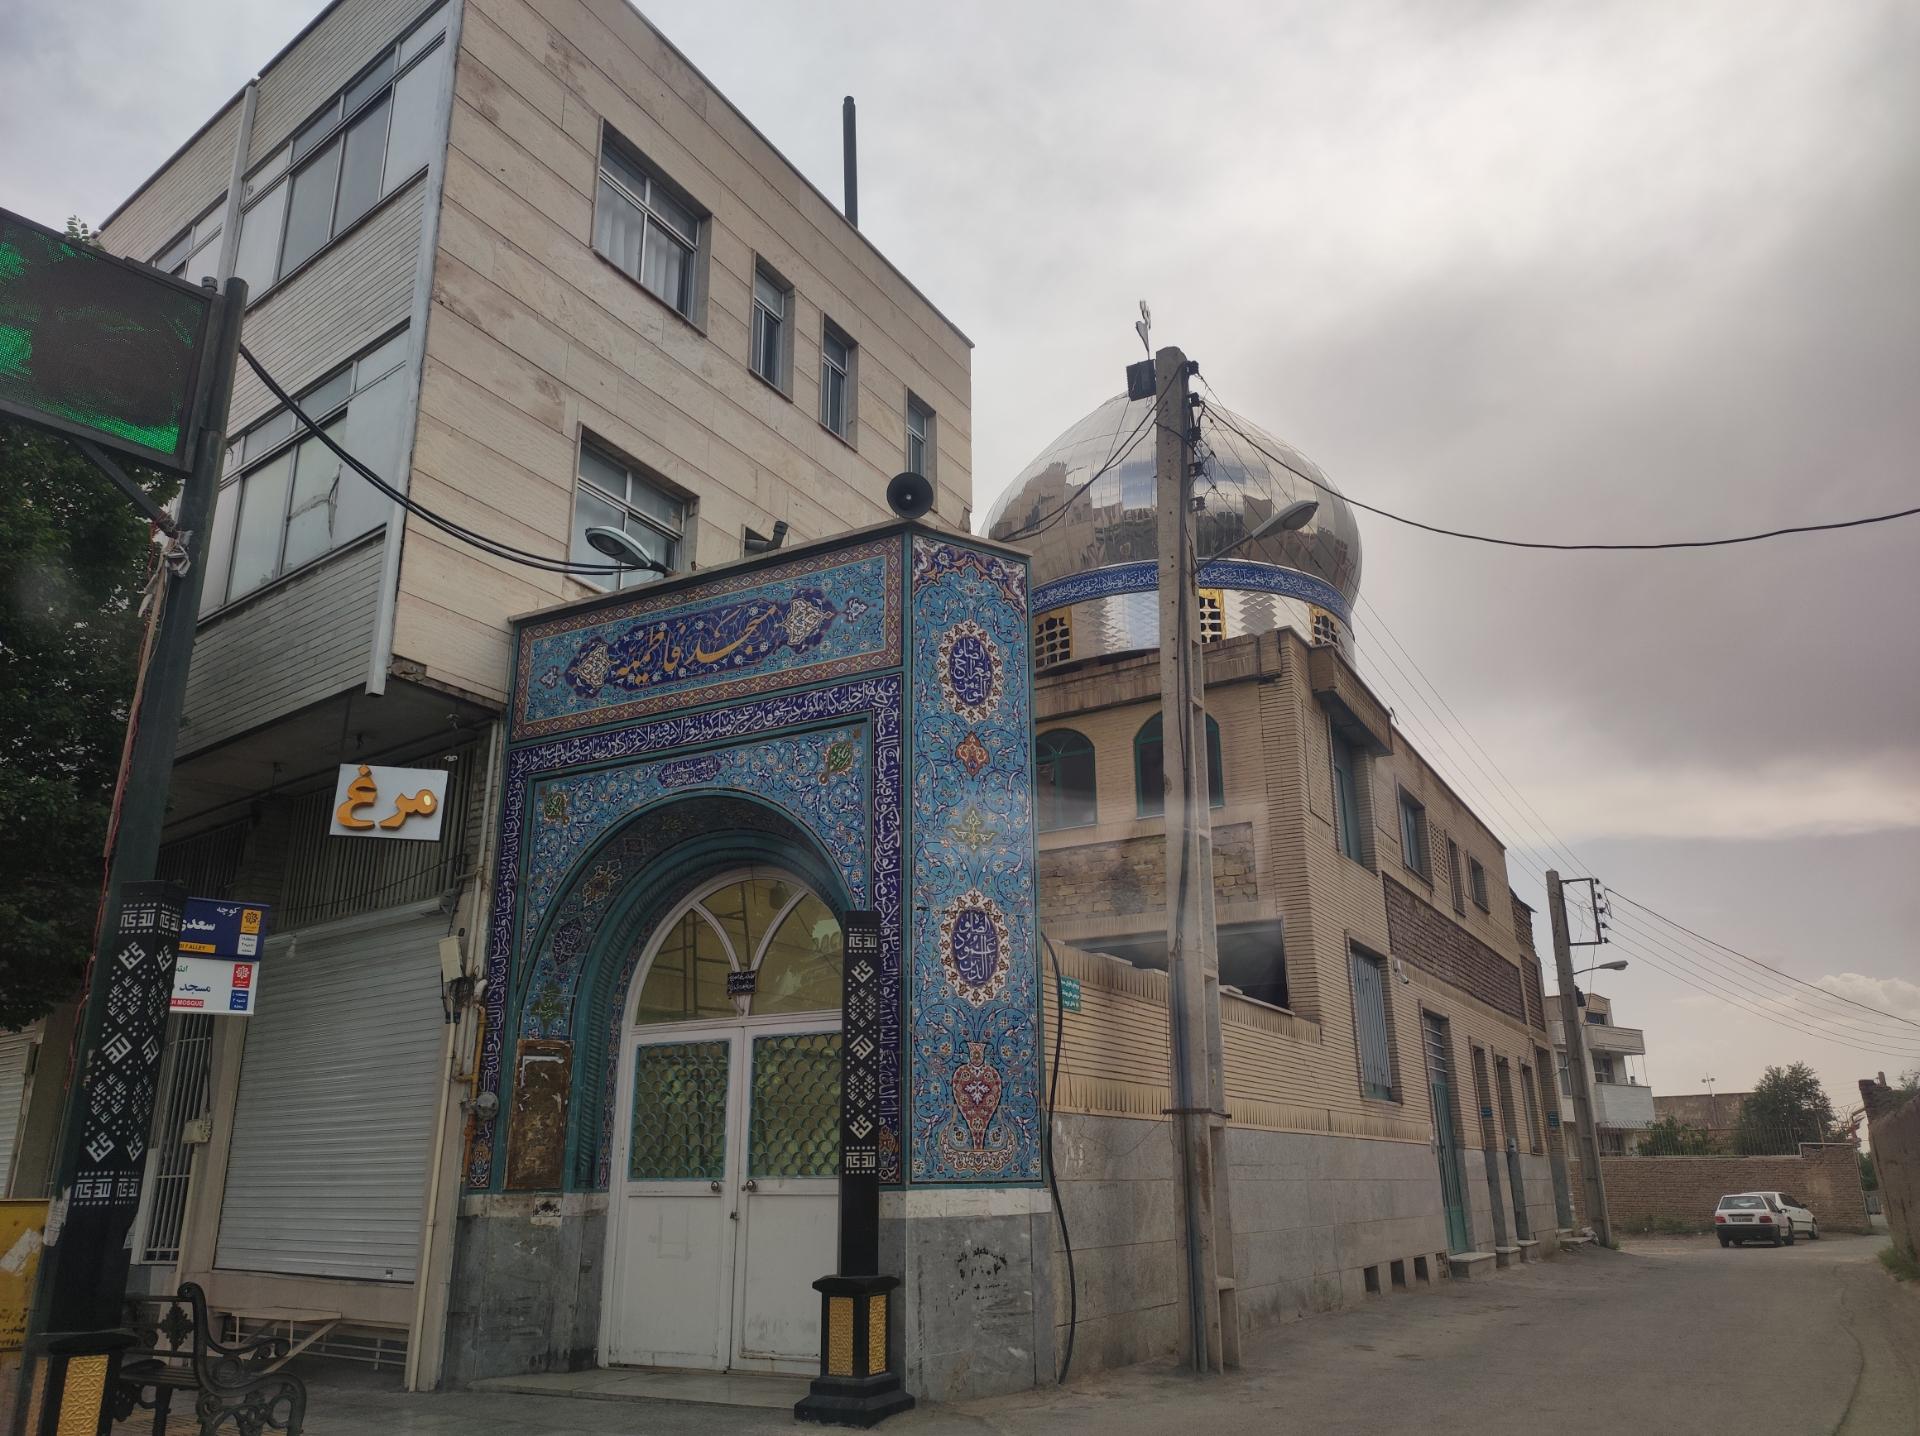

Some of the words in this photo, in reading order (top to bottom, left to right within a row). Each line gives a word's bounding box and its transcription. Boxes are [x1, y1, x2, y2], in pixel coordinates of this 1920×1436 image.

[684, 604, 777, 666] مسجد
[336, 763, 438, 829] مرغ
[217, 906, 240, 917] کوچه
[179, 983, 211, 995] مسجد
[177, 999, 204, 1007] MOSQUE
